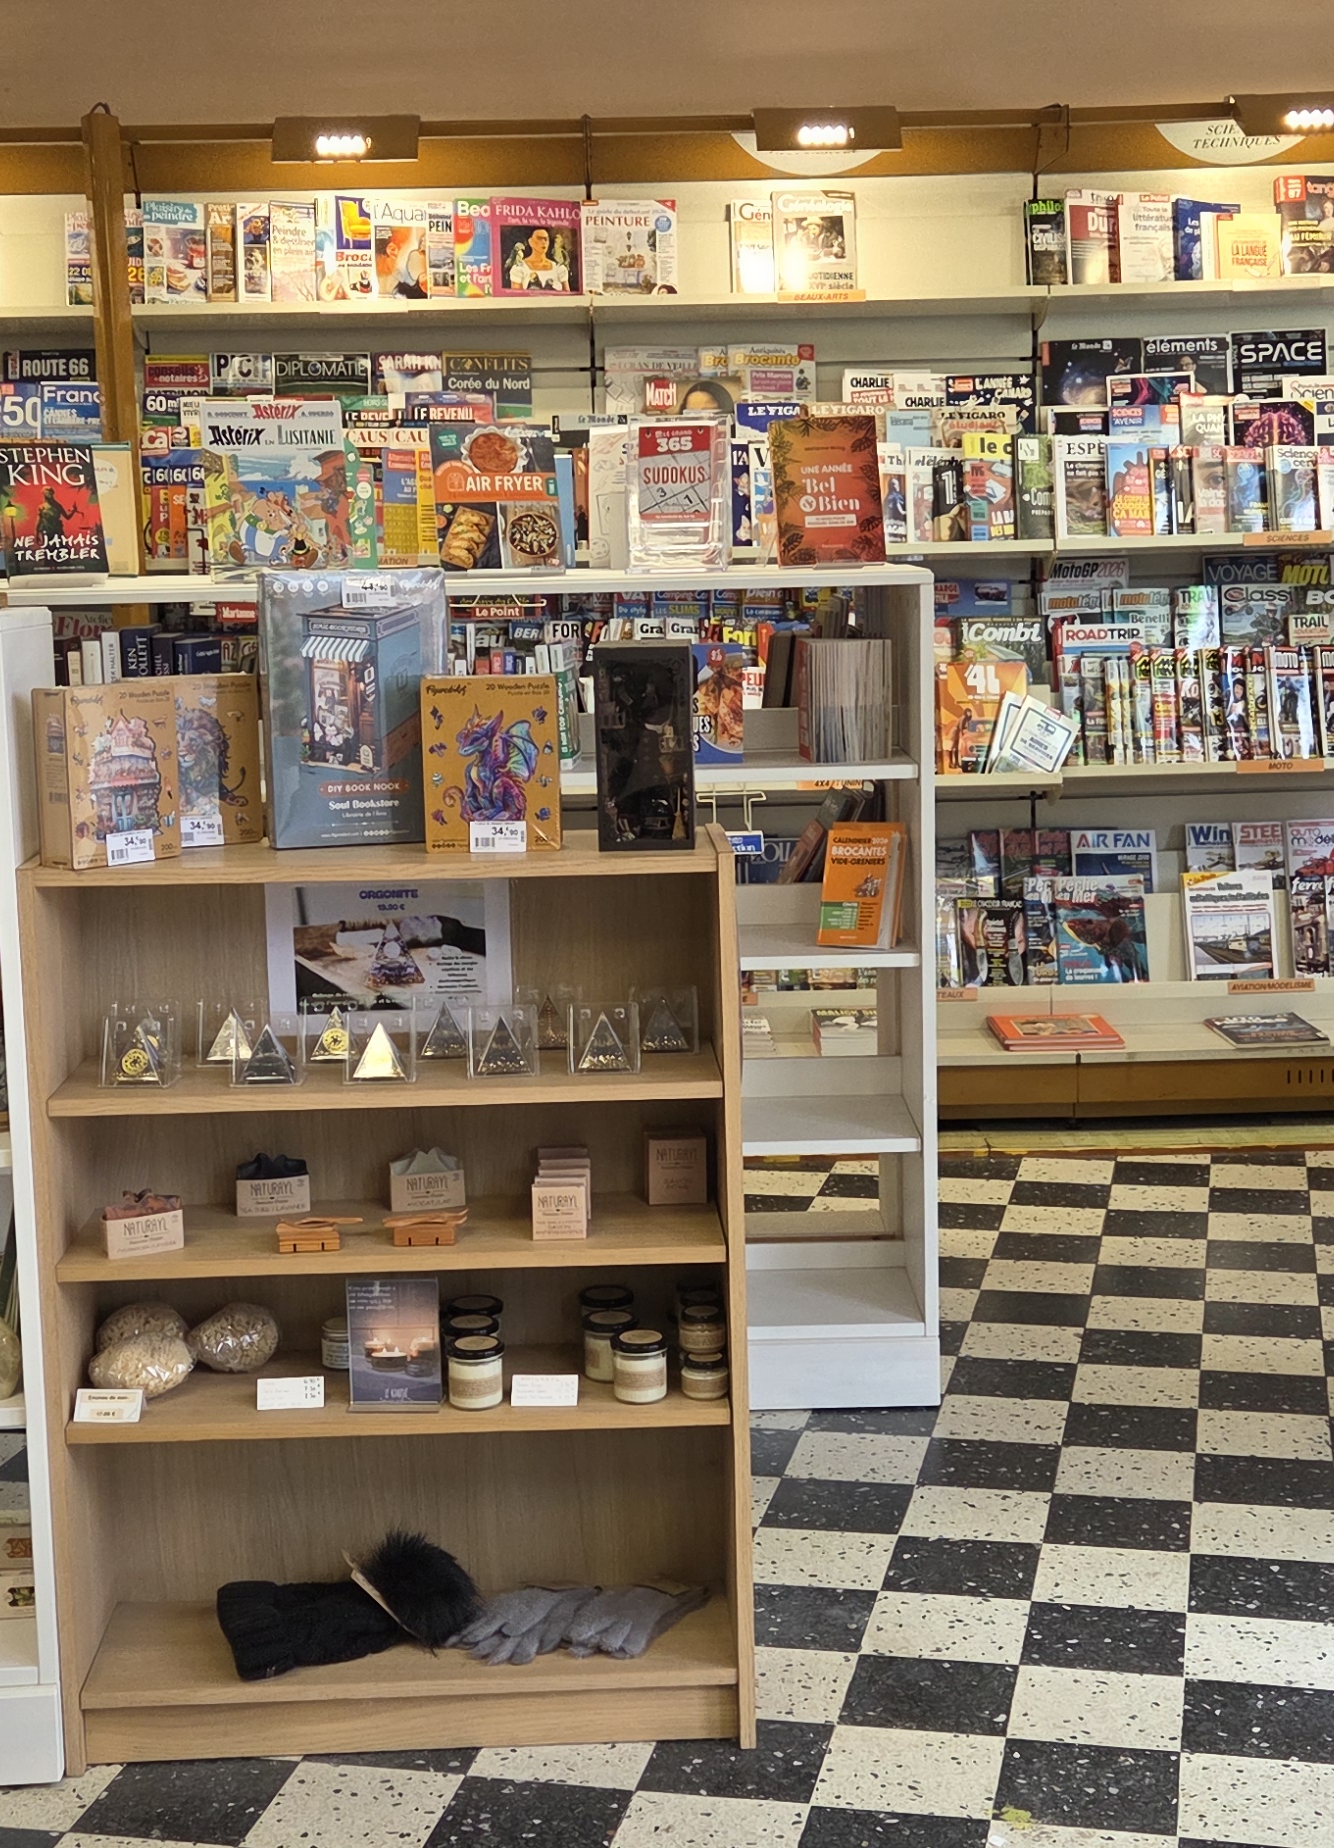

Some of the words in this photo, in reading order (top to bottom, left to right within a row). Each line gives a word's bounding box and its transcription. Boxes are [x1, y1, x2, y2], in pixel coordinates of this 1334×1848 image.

[1193, 135, 1282, 150] TECHNIQUES
[495, 204, 533, 217] FRIDA
[536, 206, 581, 219] KAHLO
[585, 216, 651, 227] PEINTURE
[794, 292, 849, 302] BEAUX-ARTS
[1146, 339, 1218, 354] éléments
[1240, 341, 1323, 364] SPACE
[22, 358, 67, 378] ROUTE
[68, 358, 89, 377] 66
[276, 360, 367, 377] DIPLOMATIE
[450, 356, 529, 371] CONFLITS
[448, 377, 483, 390] Corée
[485, 377, 500, 389] du
[502, 377, 531, 390] Nord
[850, 377, 890, 389] CHARLIE
[145, 396, 166, 412] 60
[904, 396, 945, 408] CHARLIE
[251, 403, 302, 421] Astérix
[429, 407, 473, 420] REVENU
[831, 404, 886, 416] FIGARO
[208, 425, 266, 446] Astérix
[277, 424, 336, 446] LUSITANIE
[656, 437, 693, 452] 365
[7, 464, 85, 486] KING
[643, 466, 706, 485] SUDOKUS
[466, 475, 491, 492] AIR
[495, 475, 543, 492] FRYER
[804, 477, 836, 493] Bel
[657, 487, 667, 498] 3
[684, 494, 693, 505] 1
[818, 496, 861, 512] Bien
[13, 535, 37, 549] NE
[41, 535, 99, 550] JAMAIS
[1266, 533, 1310, 543] SCIENCES
[14, 548, 100, 562] TREMBLER
[1050, 561, 1098, 581] MotoGP
[1097, 560, 1126, 578] 2026
[475, 607, 489, 617] Le
[490, 607, 520, 617] Point
[669, 606, 700, 617] SLIMS
[1292, 615, 1329, 629] TRAIL
[552, 623, 580, 638] FOR
[969, 622, 1042, 643] Combi
[1066, 627, 1141, 642] ROADTRIP
[497, 682, 527, 691] Wooden
[528, 683, 550, 691] Puzzle
[1268, 761, 1294, 771] MOTO
[327, 783, 342, 793] DIY
[344, 782, 371, 793] BOOK
[373, 782, 400, 792] NOOK
[328, 799, 350, 810] Soul
[352, 798, 400, 810] Bookstore
[1076, 832, 1109, 849] AIR
[1113, 831, 1151, 848] FAN
[831, 845, 887, 857] BROCANTES
[830, 857, 885, 865] VIDE-GRENIERS
[359, 889, 419, 899] ORGONITE
